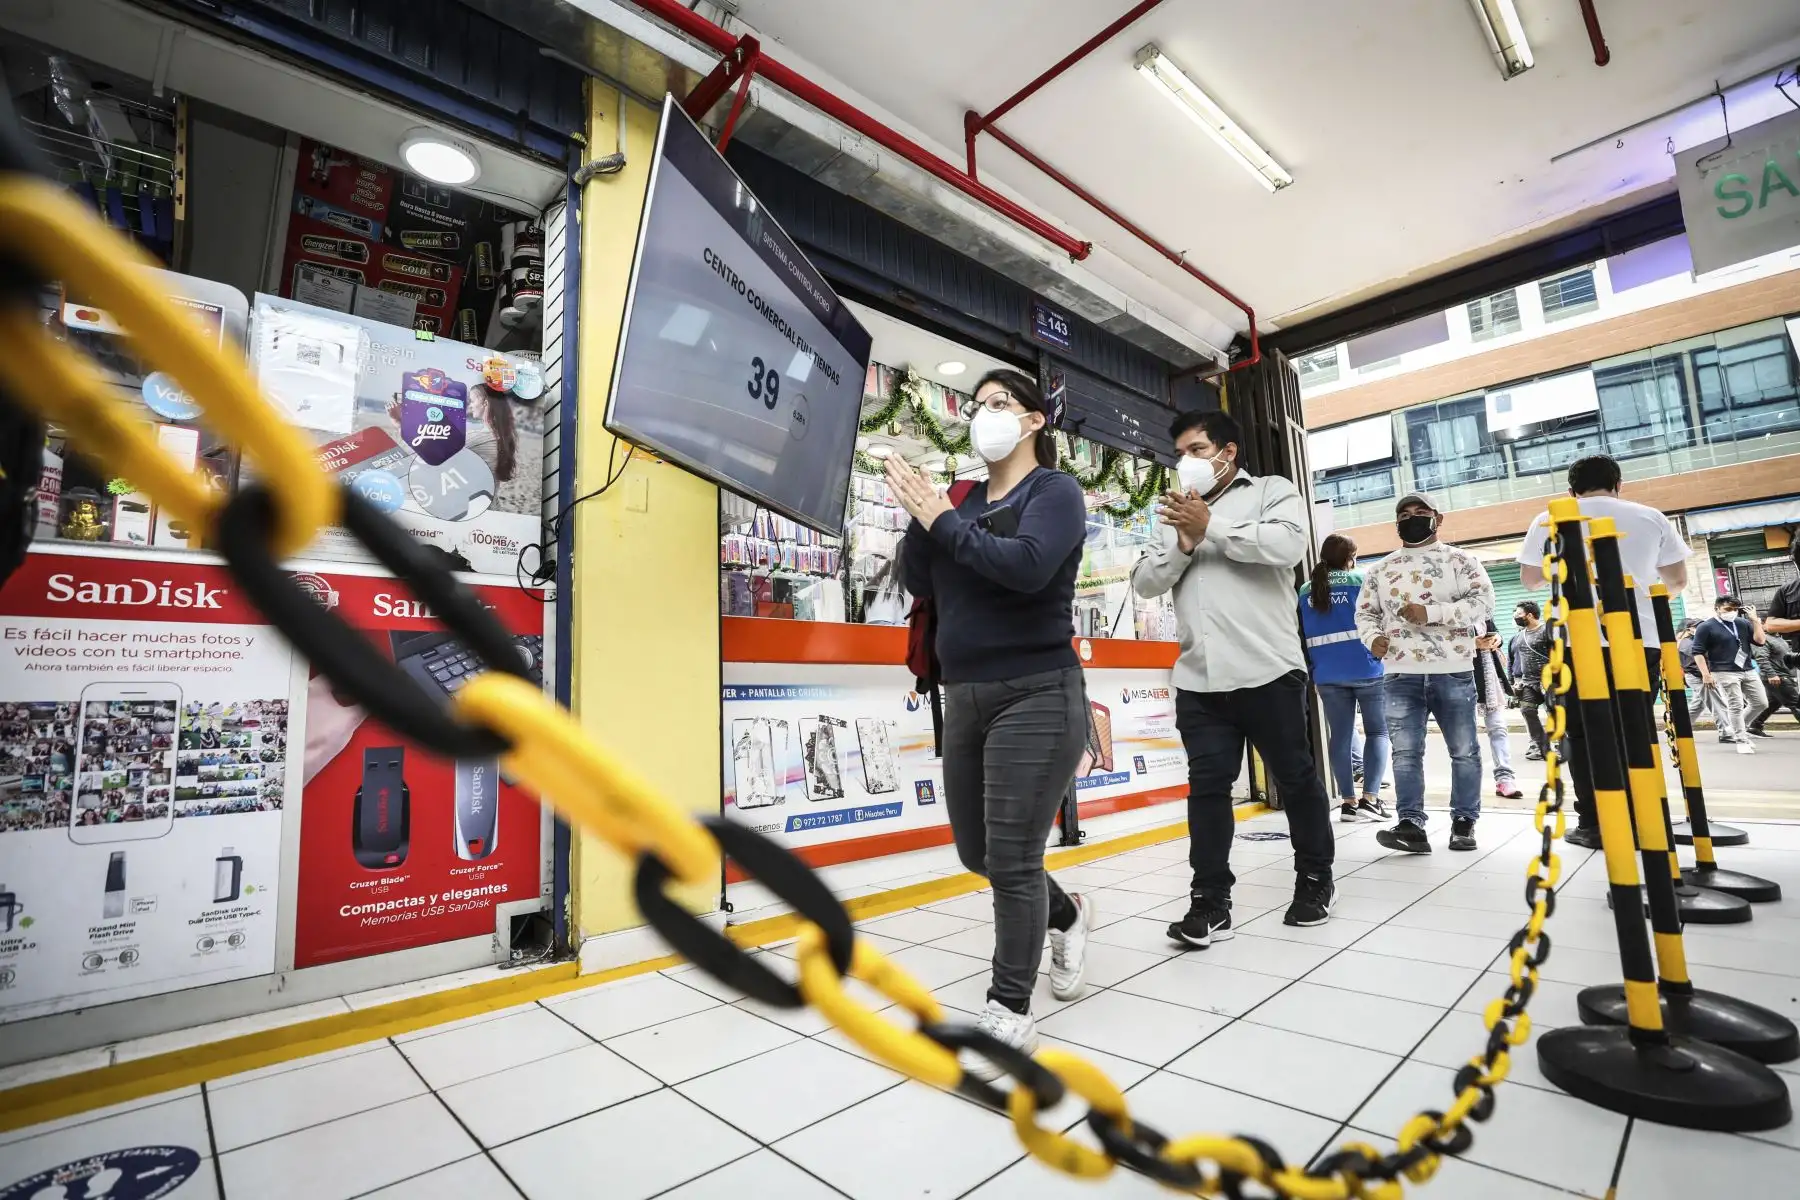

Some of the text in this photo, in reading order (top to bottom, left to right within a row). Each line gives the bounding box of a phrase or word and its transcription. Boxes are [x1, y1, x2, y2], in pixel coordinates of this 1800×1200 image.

[1714, 148, 1800, 219] SA
[303, 239, 336, 250] Energizer
[416, 238, 440, 246] GOLD
[401, 264, 428, 276] GOLD
[763, 231, 830, 312] SISTEMA CONTROL AFORO
[703, 247, 746, 296] CENTRO
[747, 288, 796, 345] COMERCIAL
[813, 351, 840, 386] TIENDAS
[1047, 317, 1068, 336] 143
[747, 356, 781, 411] 39
[154, 385, 195, 405] Vale
[411, 424, 451, 446] yape
[440, 467, 469, 496] A1
[361, 486, 392, 503] Vale
[472, 533, 493, 545] 100
[4, 627, 255, 646] Es fácil hacer muchas fotos y
[14, 644, 245, 663] videos con tu smartphone.
[24, 662, 62, 672] Ahora
[65, 662, 114, 673] también
[132, 662, 155, 673] fácil
[157, 663, 190, 673] liberar
[748, 688, 786, 698] PANTALLA
[787, 688, 797, 698] DE
[1131, 689, 1169, 699] MISATEC
[471, 766, 485, 816] SanDisk
[803, 817, 816, 826] 972
[816, 816, 826, 825] 72
[827, 813, 843, 824] 1787
[864, 808, 885, 818] Misatec
[886, 807, 898, 816] Peru
[450, 867, 476, 876] Cruzer
[468, 873, 485, 881] USB
[350, 879, 379, 889] Cruzer
[370, 886, 389, 895] USB
[339, 883, 508, 917] Compactas y elegantes
[202, 908, 229, 917] SanDisk
[204, 915, 223, 923] Drive
[223, 912, 238, 920] USB
[239, 909, 262, 918] Type-C
[360, 897, 491, 928] Memorias USB SanDisk
[119, 921, 136, 929] Mini
[88, 928, 134, 940] Flash Drive
